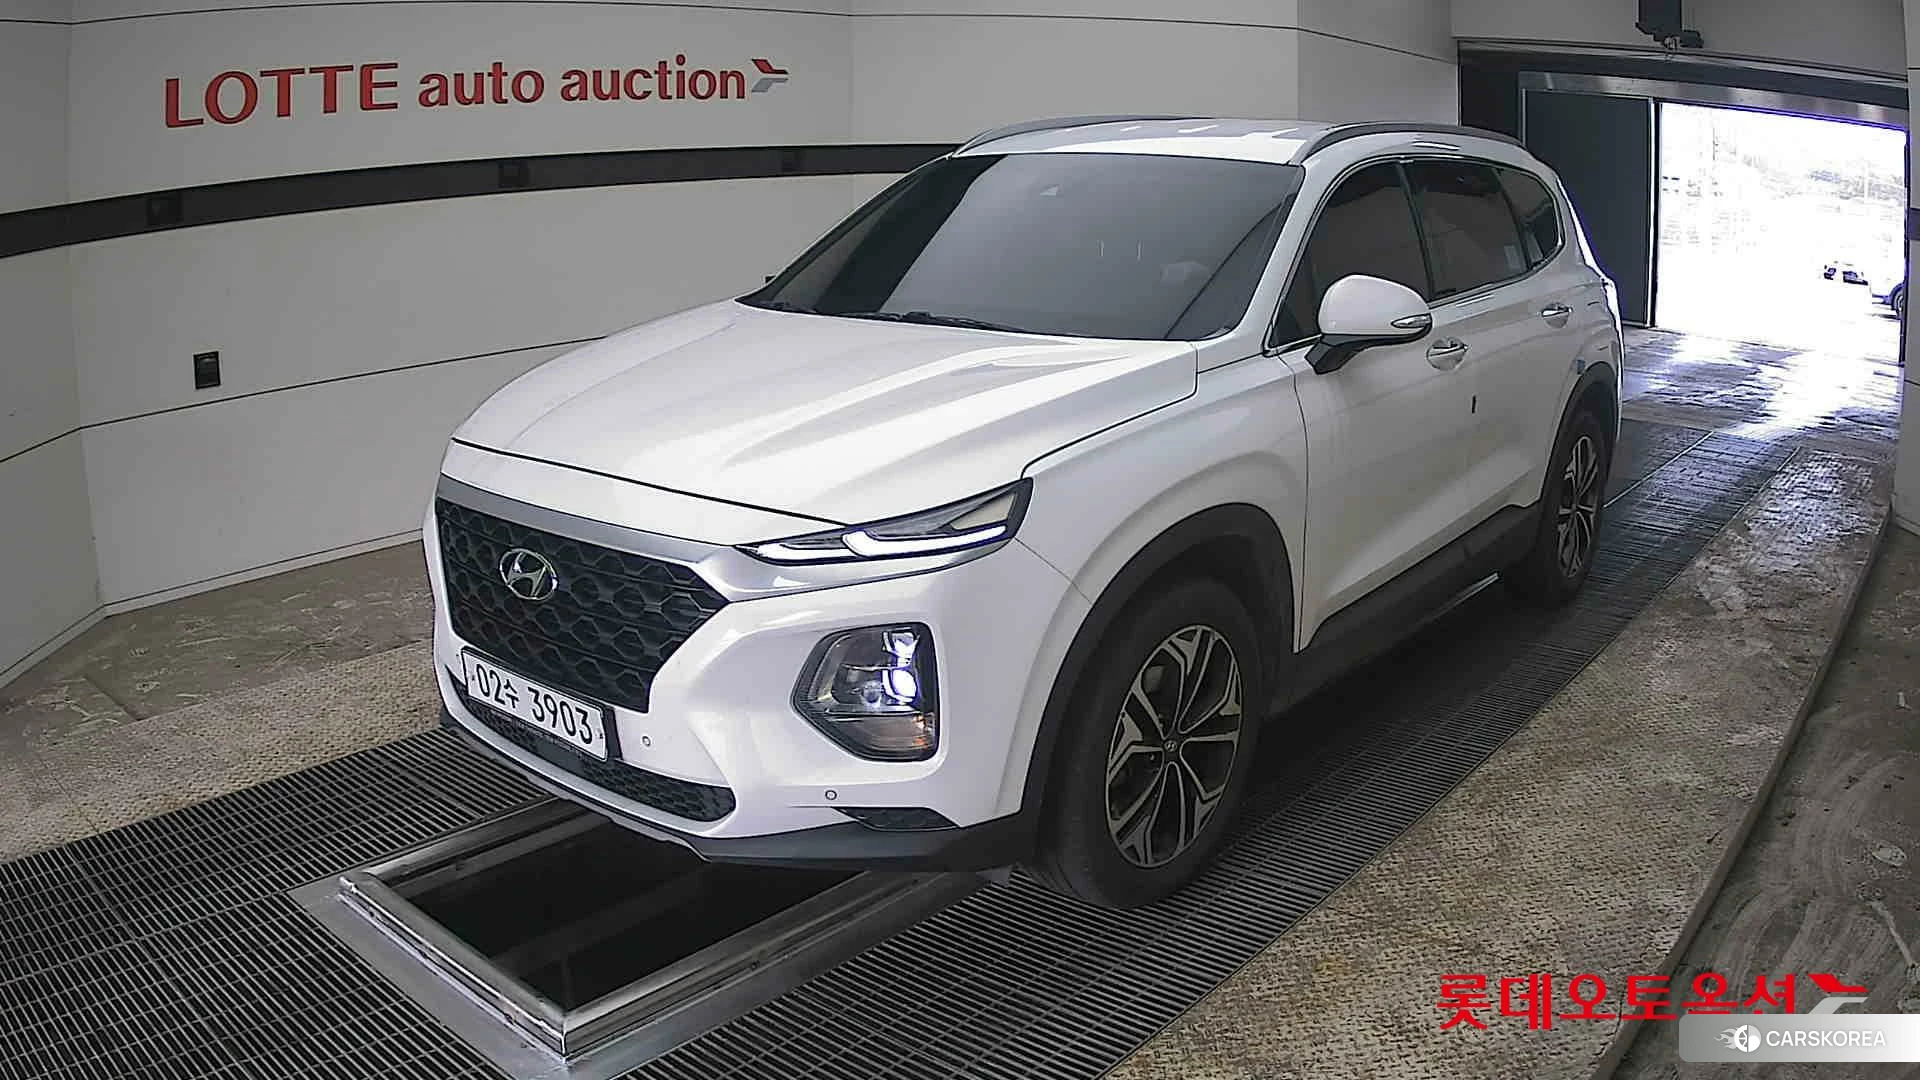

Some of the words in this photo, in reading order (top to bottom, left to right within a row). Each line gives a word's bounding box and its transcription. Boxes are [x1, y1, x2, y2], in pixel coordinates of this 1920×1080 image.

[165, 62, 399, 128] LOTTE
[418, 61, 545, 107] auto
[560, 54, 746, 102] auction
[527, 686, 593, 745] 3903
